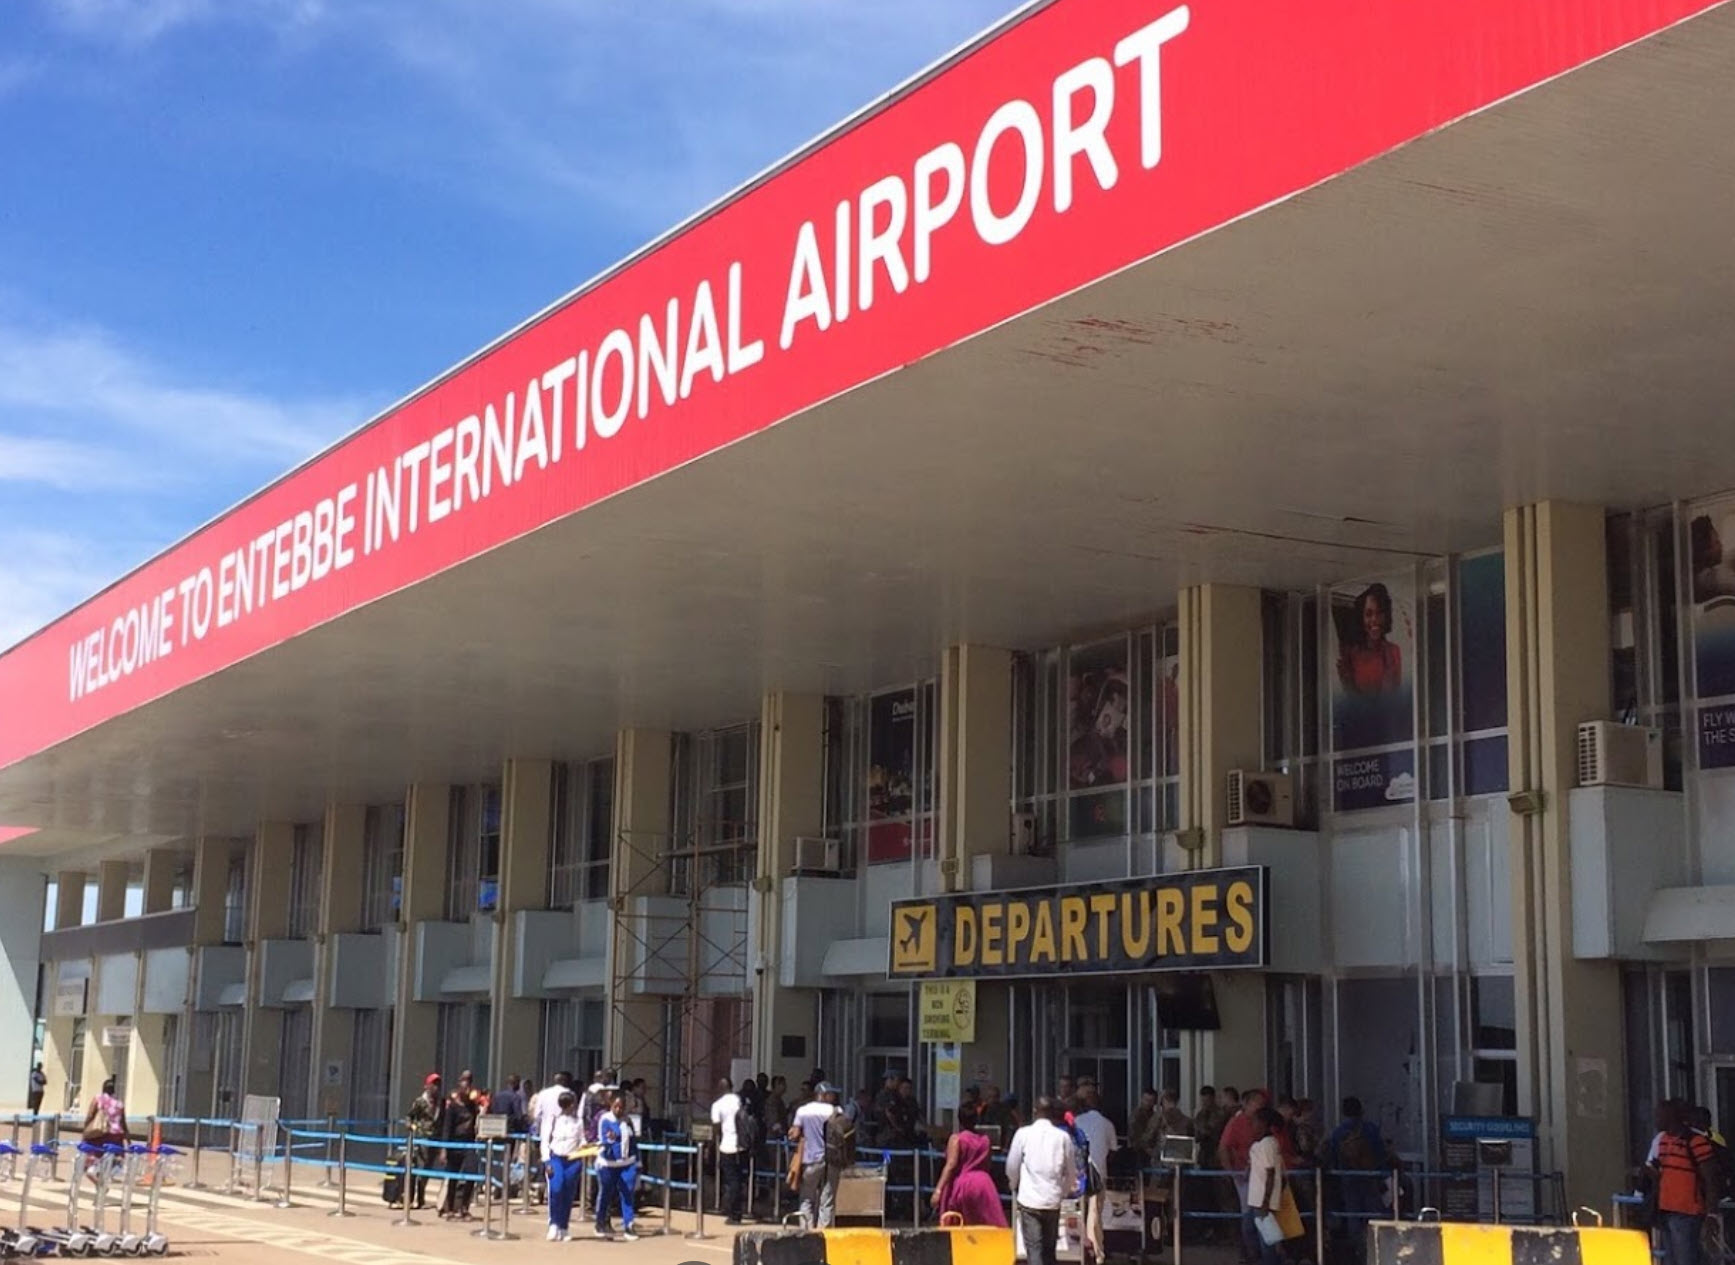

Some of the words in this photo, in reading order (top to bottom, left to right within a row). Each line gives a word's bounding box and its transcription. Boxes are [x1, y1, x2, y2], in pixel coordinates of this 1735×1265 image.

[69, 587, 176, 702] WELCOME
[178, 567, 213, 646] TO
[216, 484, 357, 627] ENTEBBE
[364, 262, 763, 555] INTERNATIONAL
[780, 6, 1189, 349] AIRPORT
[1703, 711, 1723, 727] FLY
[1703, 729, 1727, 745] THE
[1336, 759, 1380, 776] WELCOME
[1336, 779, 1351, 792] ON
[954, 881, 1253, 967] DEPARTURES
